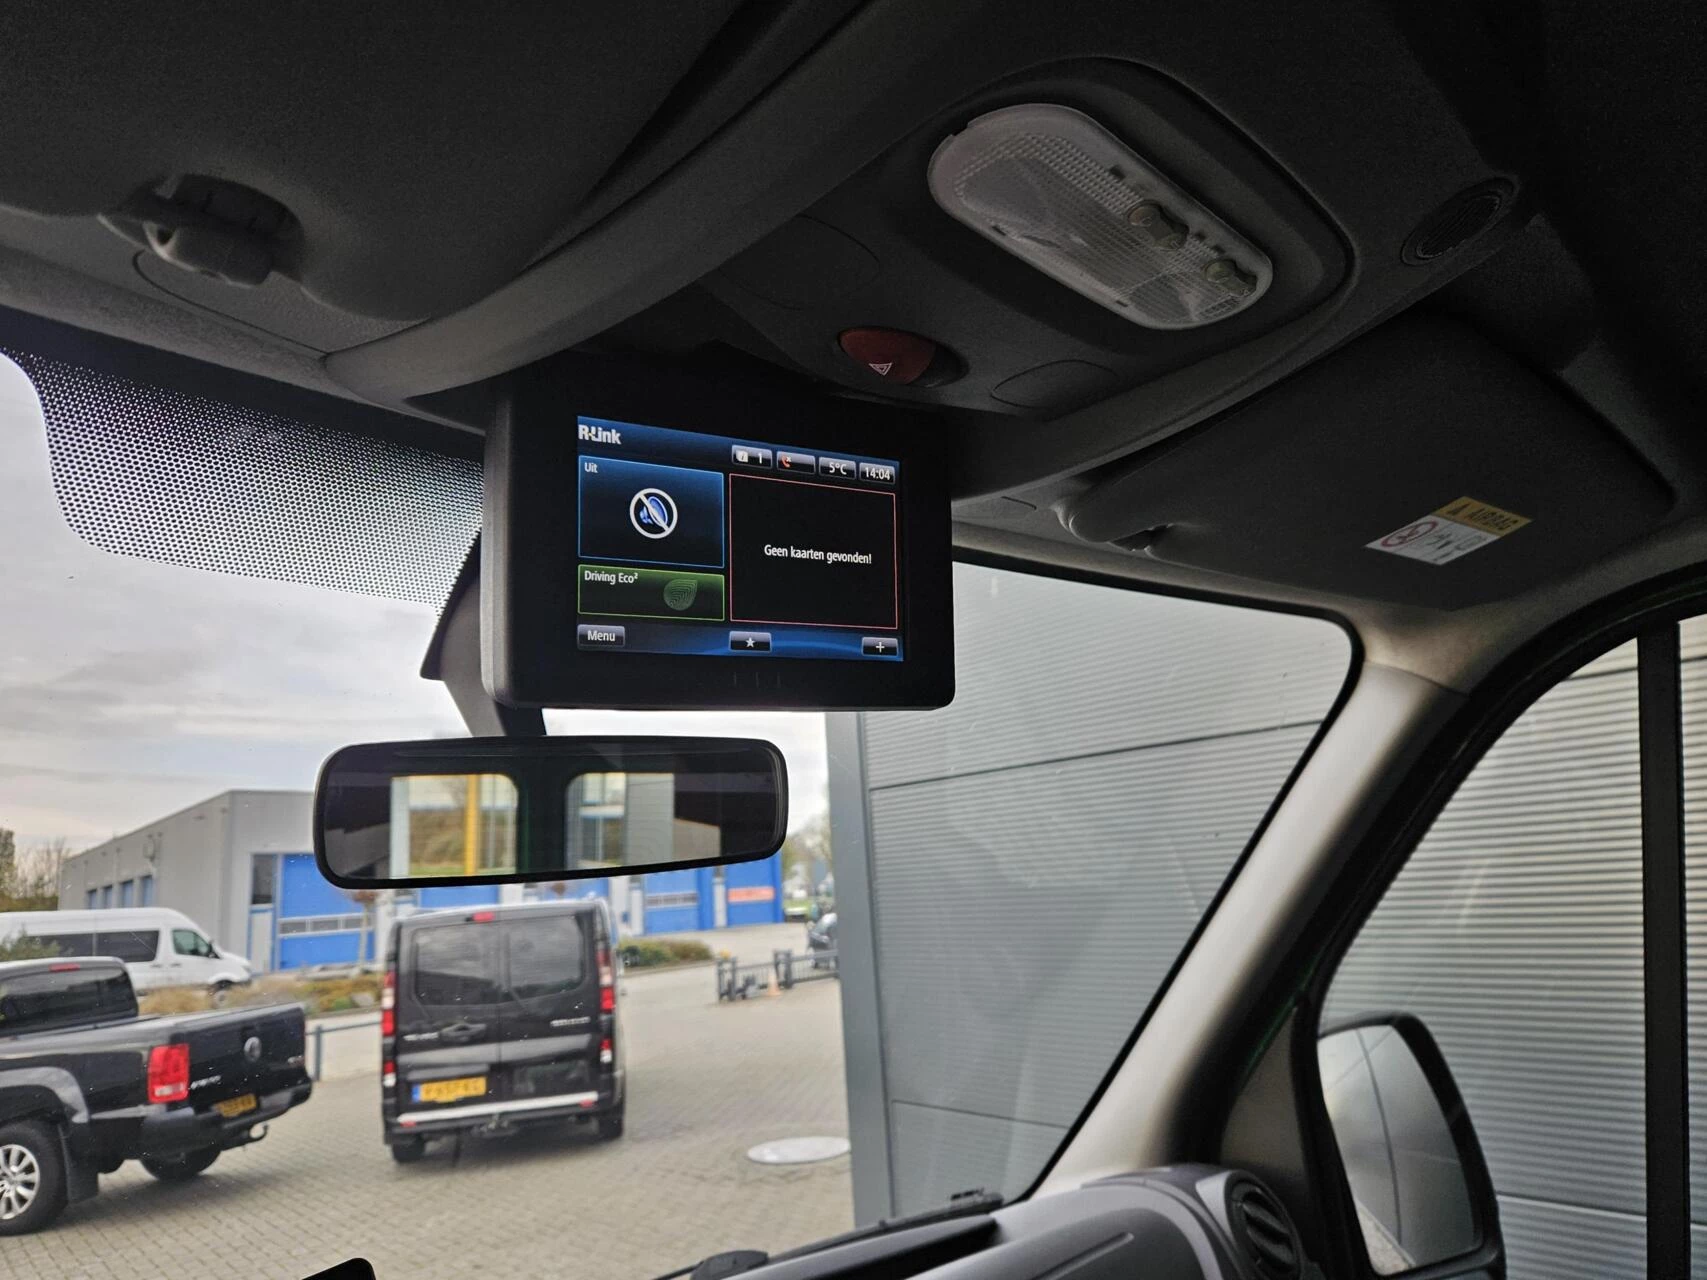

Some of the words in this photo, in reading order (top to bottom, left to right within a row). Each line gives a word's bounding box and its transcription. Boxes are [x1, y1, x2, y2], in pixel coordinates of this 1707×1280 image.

[584, 461, 598, 474] Uit
[829, 462, 847, 475] 5°C
[865, 467, 891, 481] 14:04
[764, 544, 788, 557] Geen
[790, 545, 825, 560] kaarten
[826, 551, 872, 565] gevonden!
[584, 570, 616, 585] Driving
[587, 629, 616, 642] Menu
